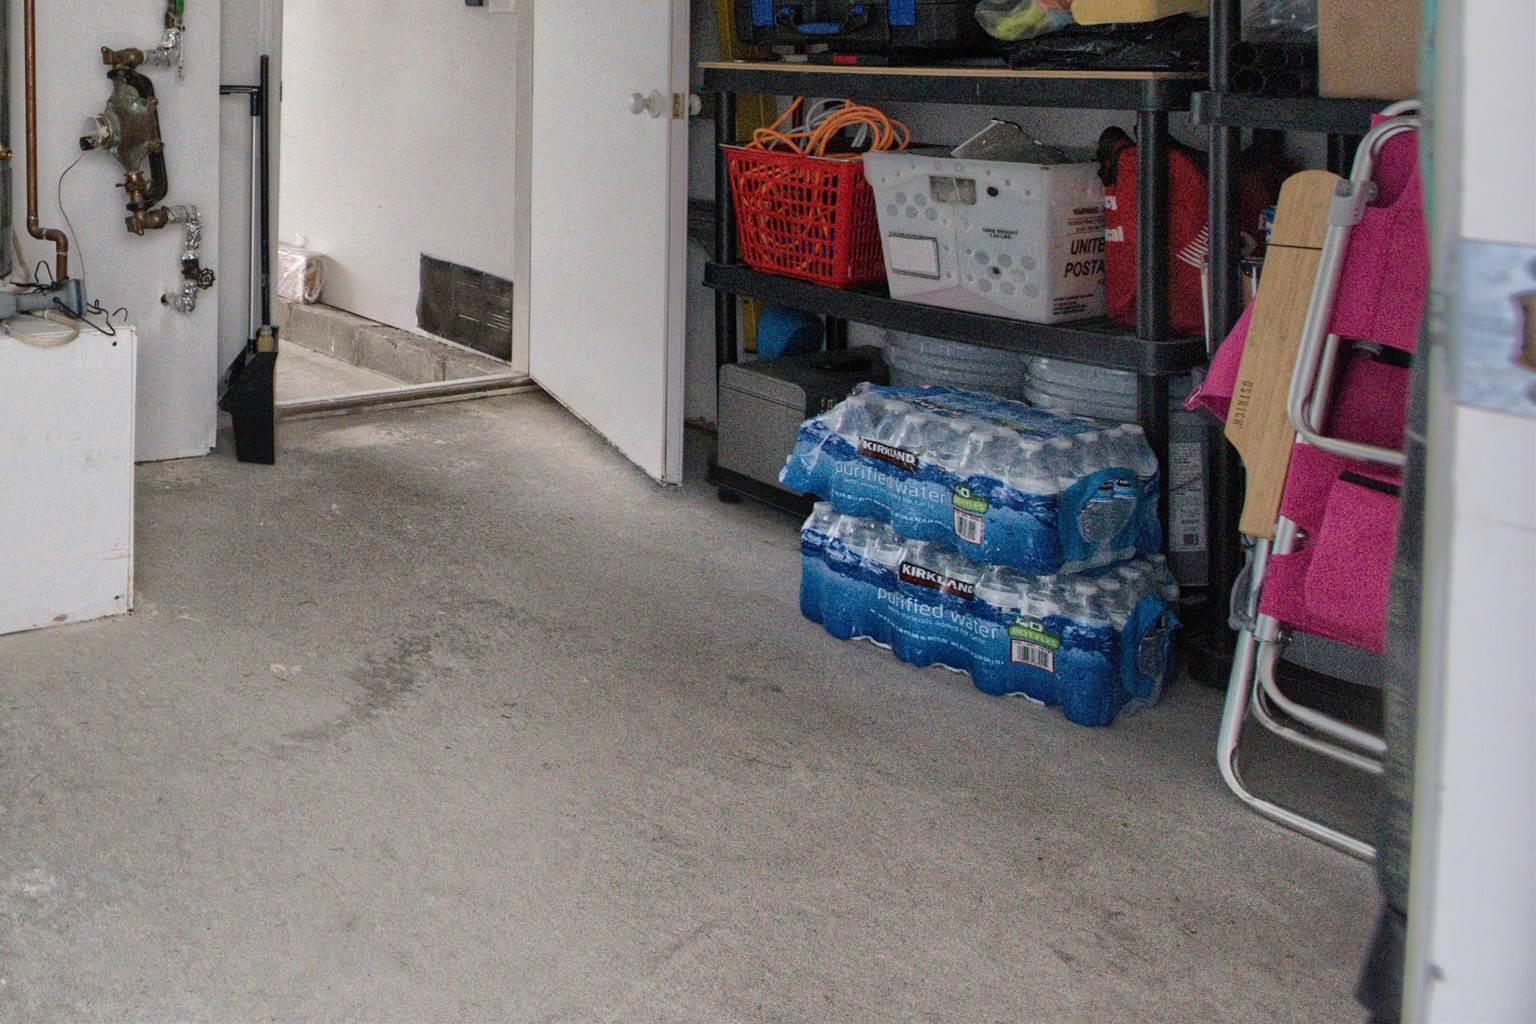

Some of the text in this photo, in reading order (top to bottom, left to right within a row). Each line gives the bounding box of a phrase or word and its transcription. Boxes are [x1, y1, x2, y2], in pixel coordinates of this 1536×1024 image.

[1233, 380, 1254, 426] OSTRICH
[862, 442, 916, 465] KIRKLAND
[835, 461, 946, 505] purified water
[877, 587, 944, 619] purified
[950, 611, 998, 640] water
